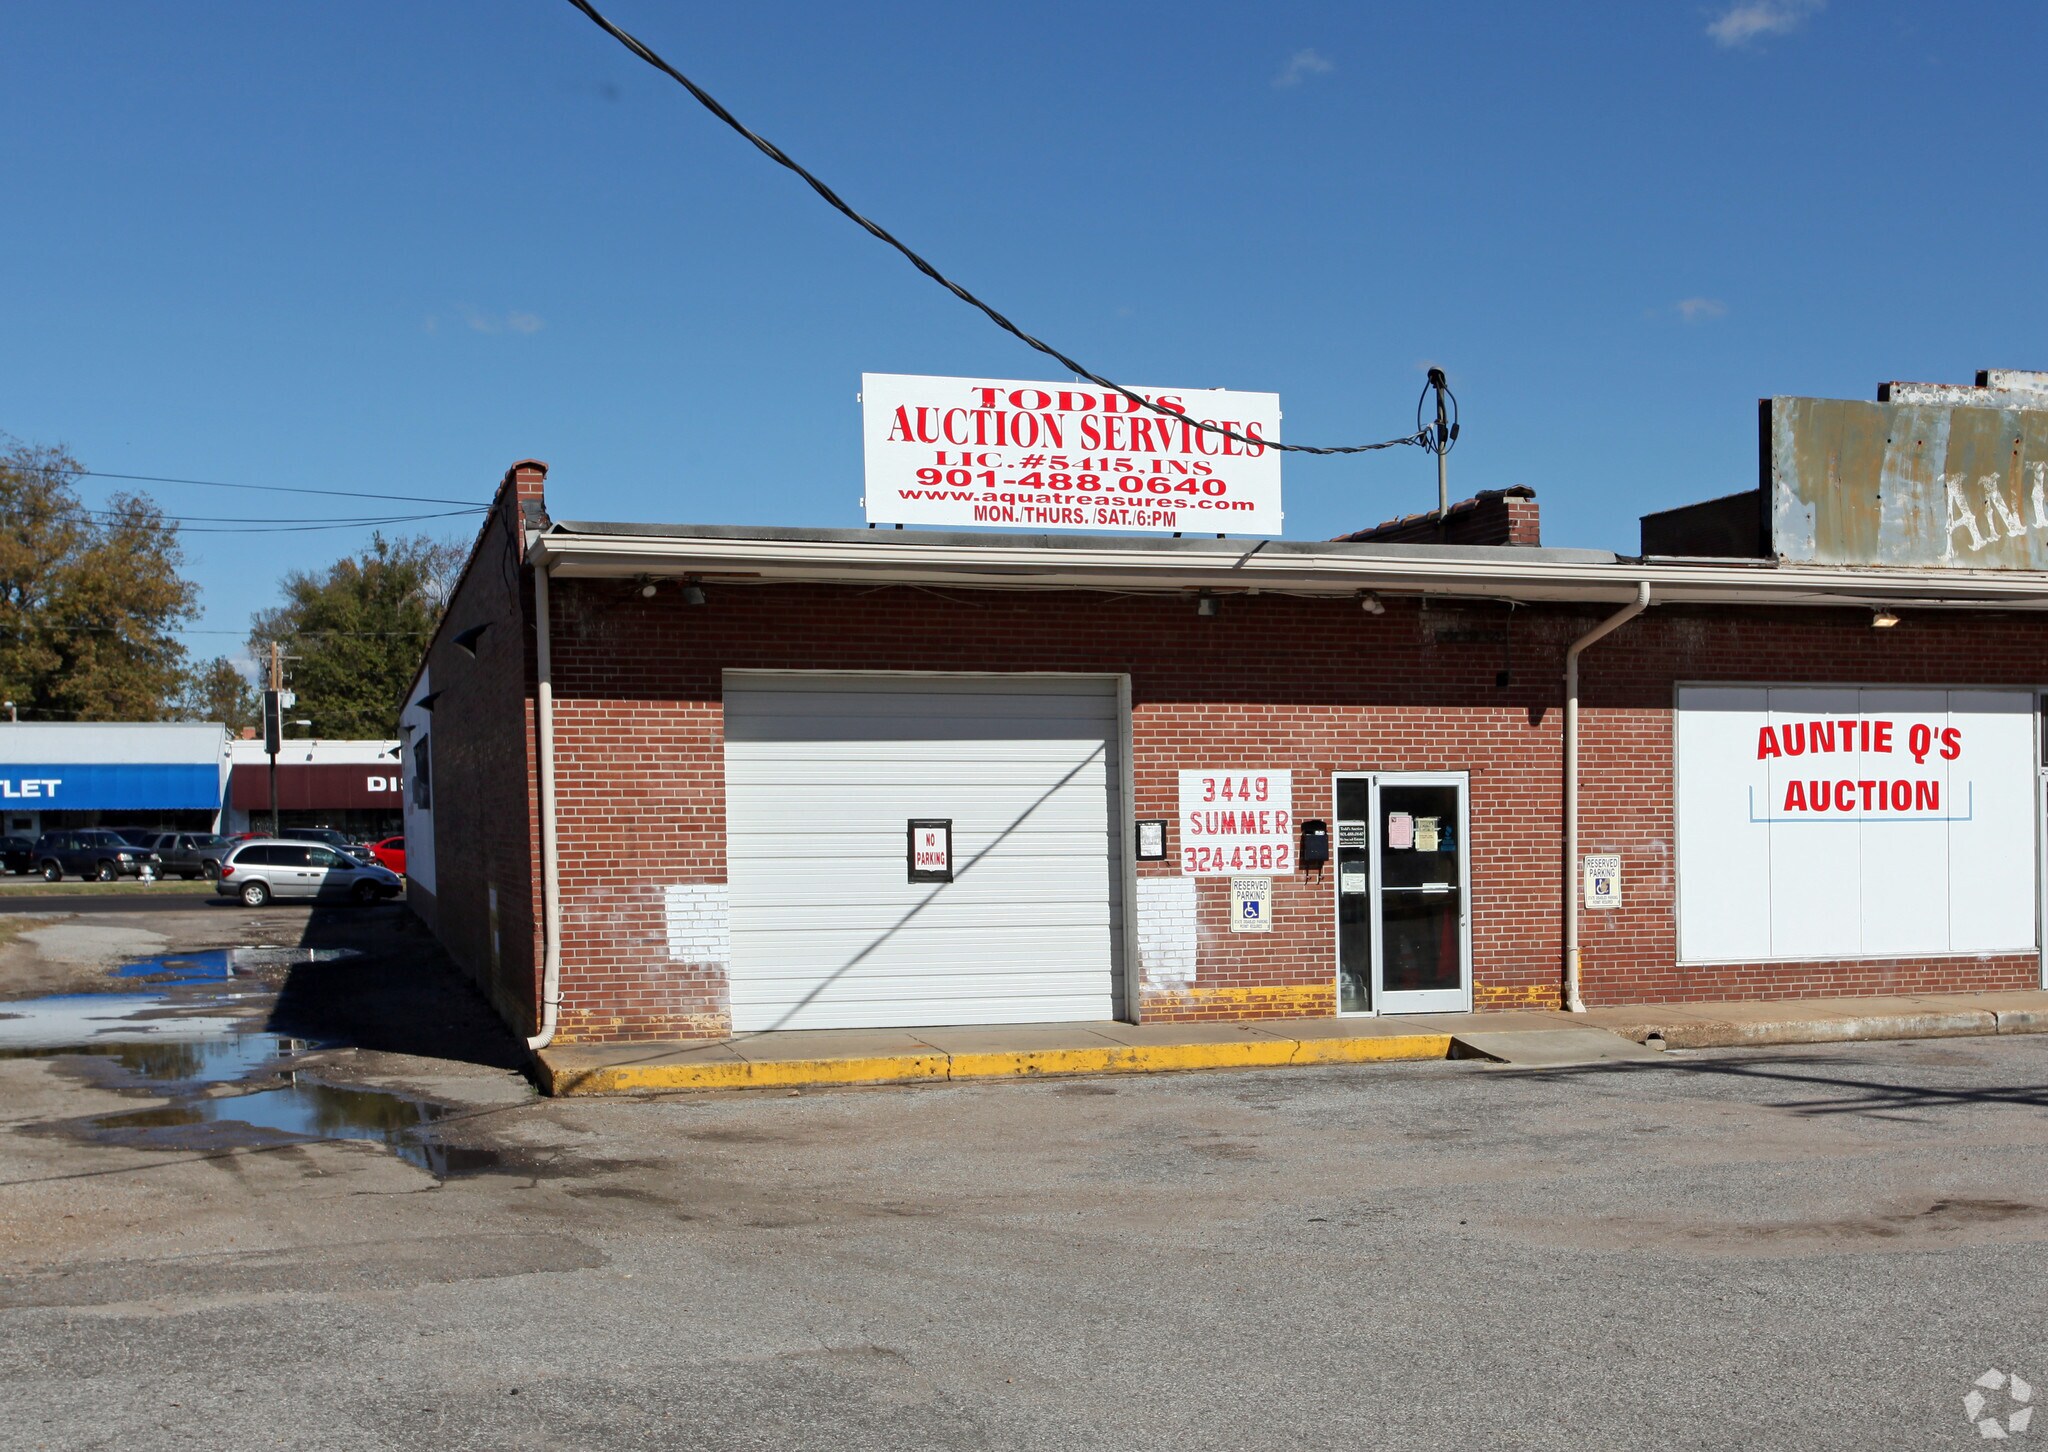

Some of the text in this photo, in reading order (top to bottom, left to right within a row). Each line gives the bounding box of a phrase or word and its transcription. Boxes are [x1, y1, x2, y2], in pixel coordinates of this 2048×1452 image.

[971, 387, 1186, 416] TODD'S
[887, 404, 1265, 458] AUCTION SERVICES
[916, 467, 1227, 497] 901-488.0640
[898, 489, 1255, 512] www.aquatreasures.com
[1757, 720, 1962, 765] AUNTIE Q'S
[0, 779, 62, 798] LET
[1202, 776, 1269, 802] 3449
[1783, 779, 1940, 812] AUCTION
[1190, 810, 1289, 835] SUMMER
[925, 833, 935, 847] NO
[916, 851, 945, 866] PARKING
[1586, 858, 1618, 868] RESERVED
[1589, 868, 1616, 878] PARKING
[1233, 880, 1268, 890] RESERVED
[1236, 890, 1265, 900] PARKING
